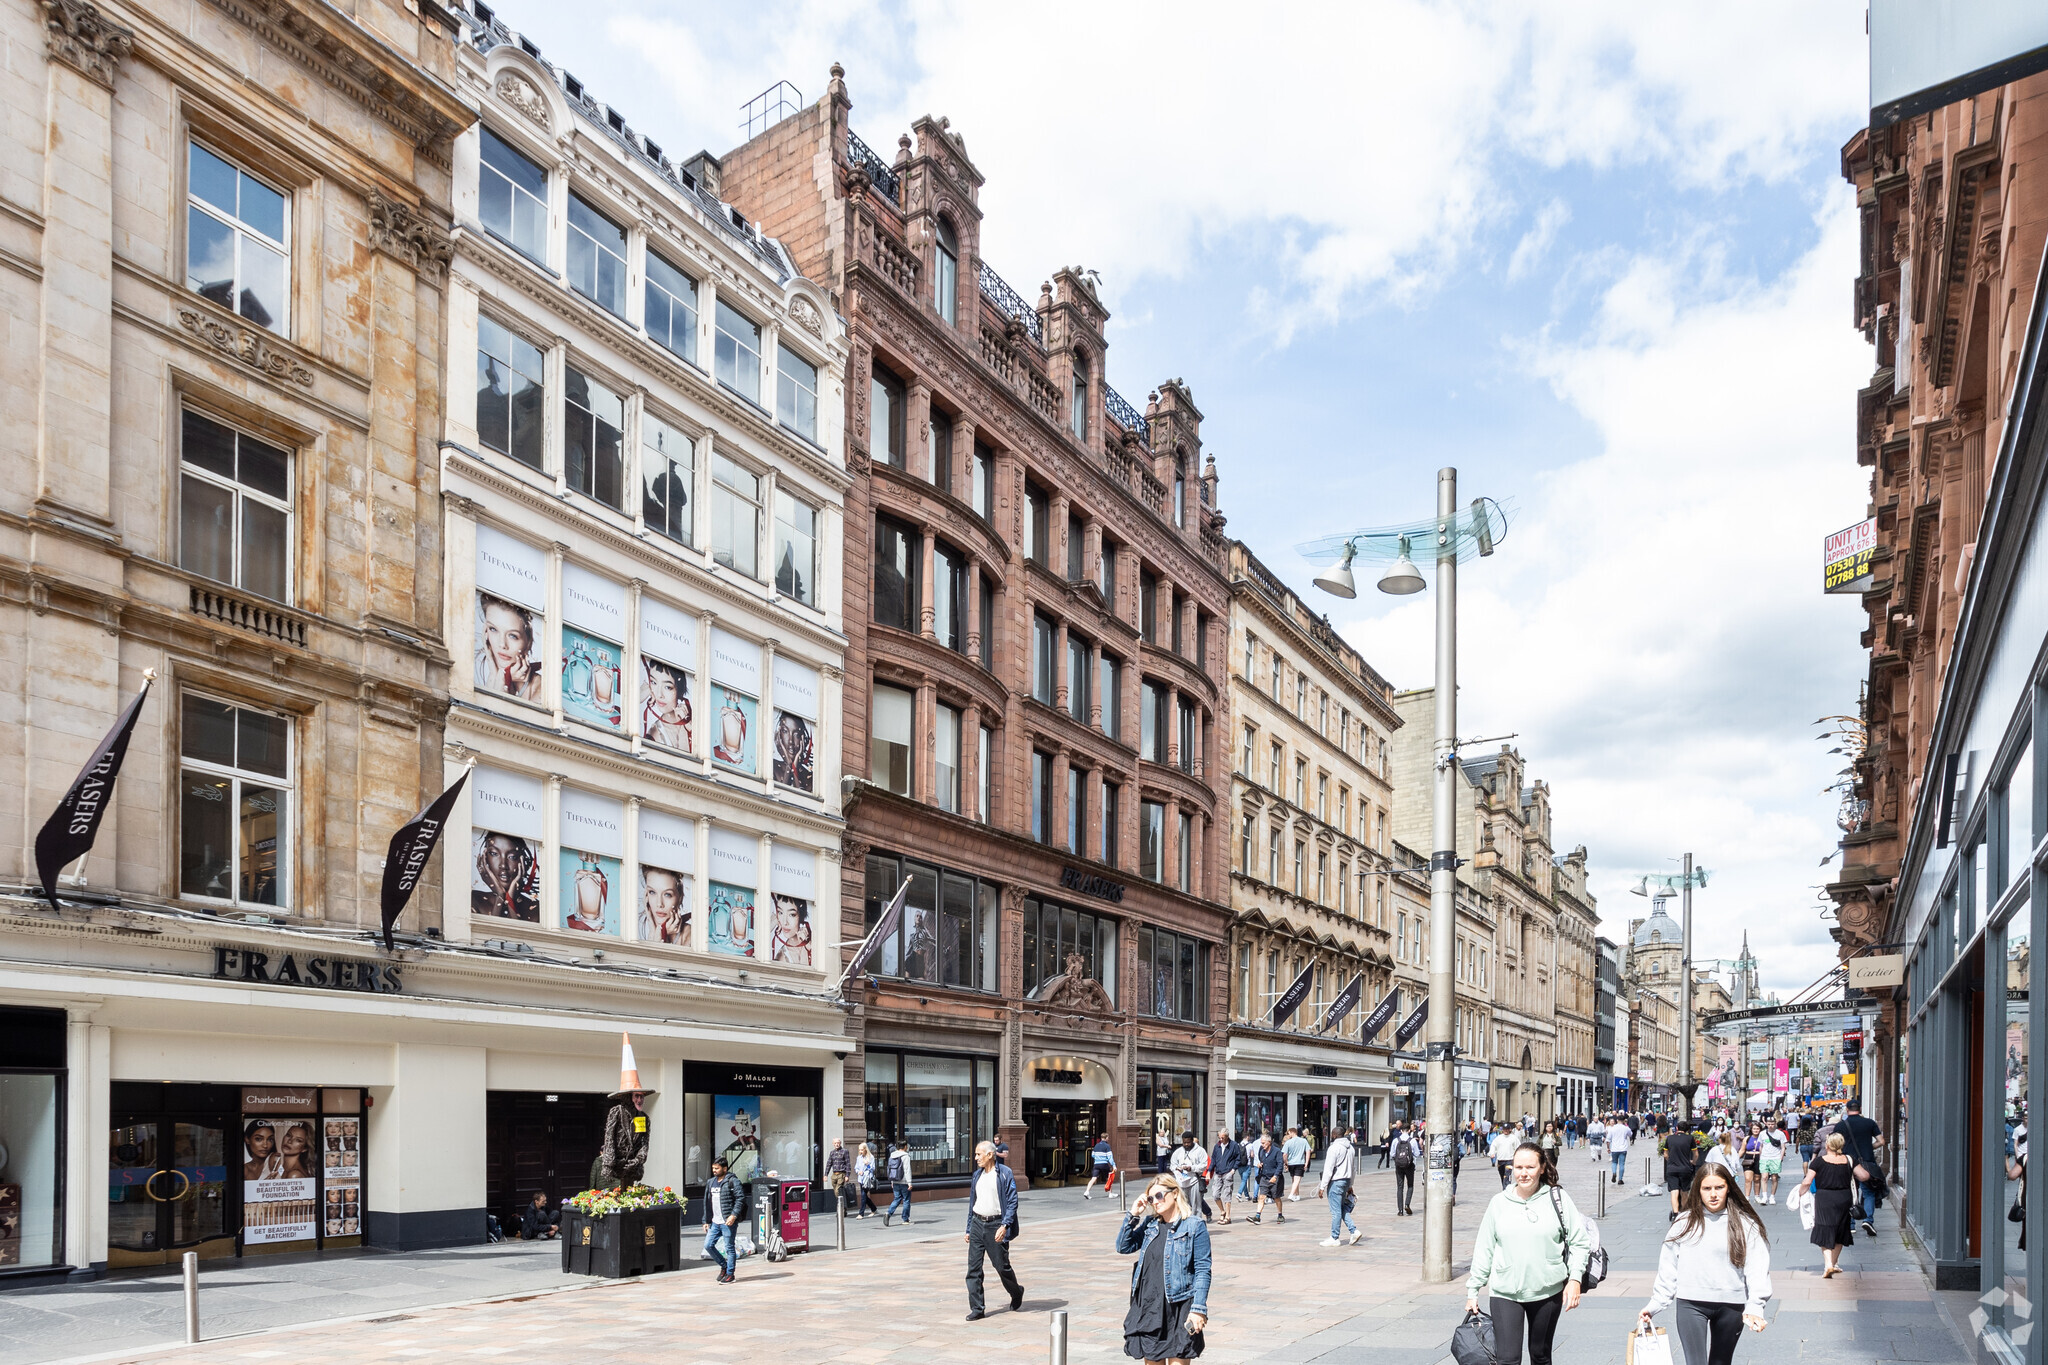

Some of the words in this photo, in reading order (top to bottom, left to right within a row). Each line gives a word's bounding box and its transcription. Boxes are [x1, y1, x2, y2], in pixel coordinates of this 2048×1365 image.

[1826, 529, 1853, 552] UNIT
[1856, 522, 1870, 540] TO
[1826, 544, 1855, 563] APPROX
[1857, 537, 1870, 551] 676
[1826, 555, 1855, 576] 07530
[1826, 568, 1855, 588] 07788
[68, 751, 115, 835] FRASERS
[398, 818, 440, 891] FRASERS
[1059, 866, 1126, 904] FRASERS
[213, 946, 403, 993] FRASERS
[1856, 966, 1896, 978] Cartier
[1279, 981, 1305, 1009] FRASERS
[1327, 993, 1351, 1020] FRASERS
[1367, 1003, 1390, 1028] FRASERS
[1728, 1010, 1752, 1020] ARCADE
[1776, 1005, 1811, 1014] ARGYLL
[1816, 1000, 1858, 1010] ARCADE
[1401, 1012, 1422, 1035] FRASERS
[906, 1061, 936, 1070] CHRISTIAN
[256, 1186, 290, 1194] BEAUTIFUL
[261, 1191, 301, 1199] FOUNDATION
[267, 1225, 308, 1234] BEAUTIFULLY
